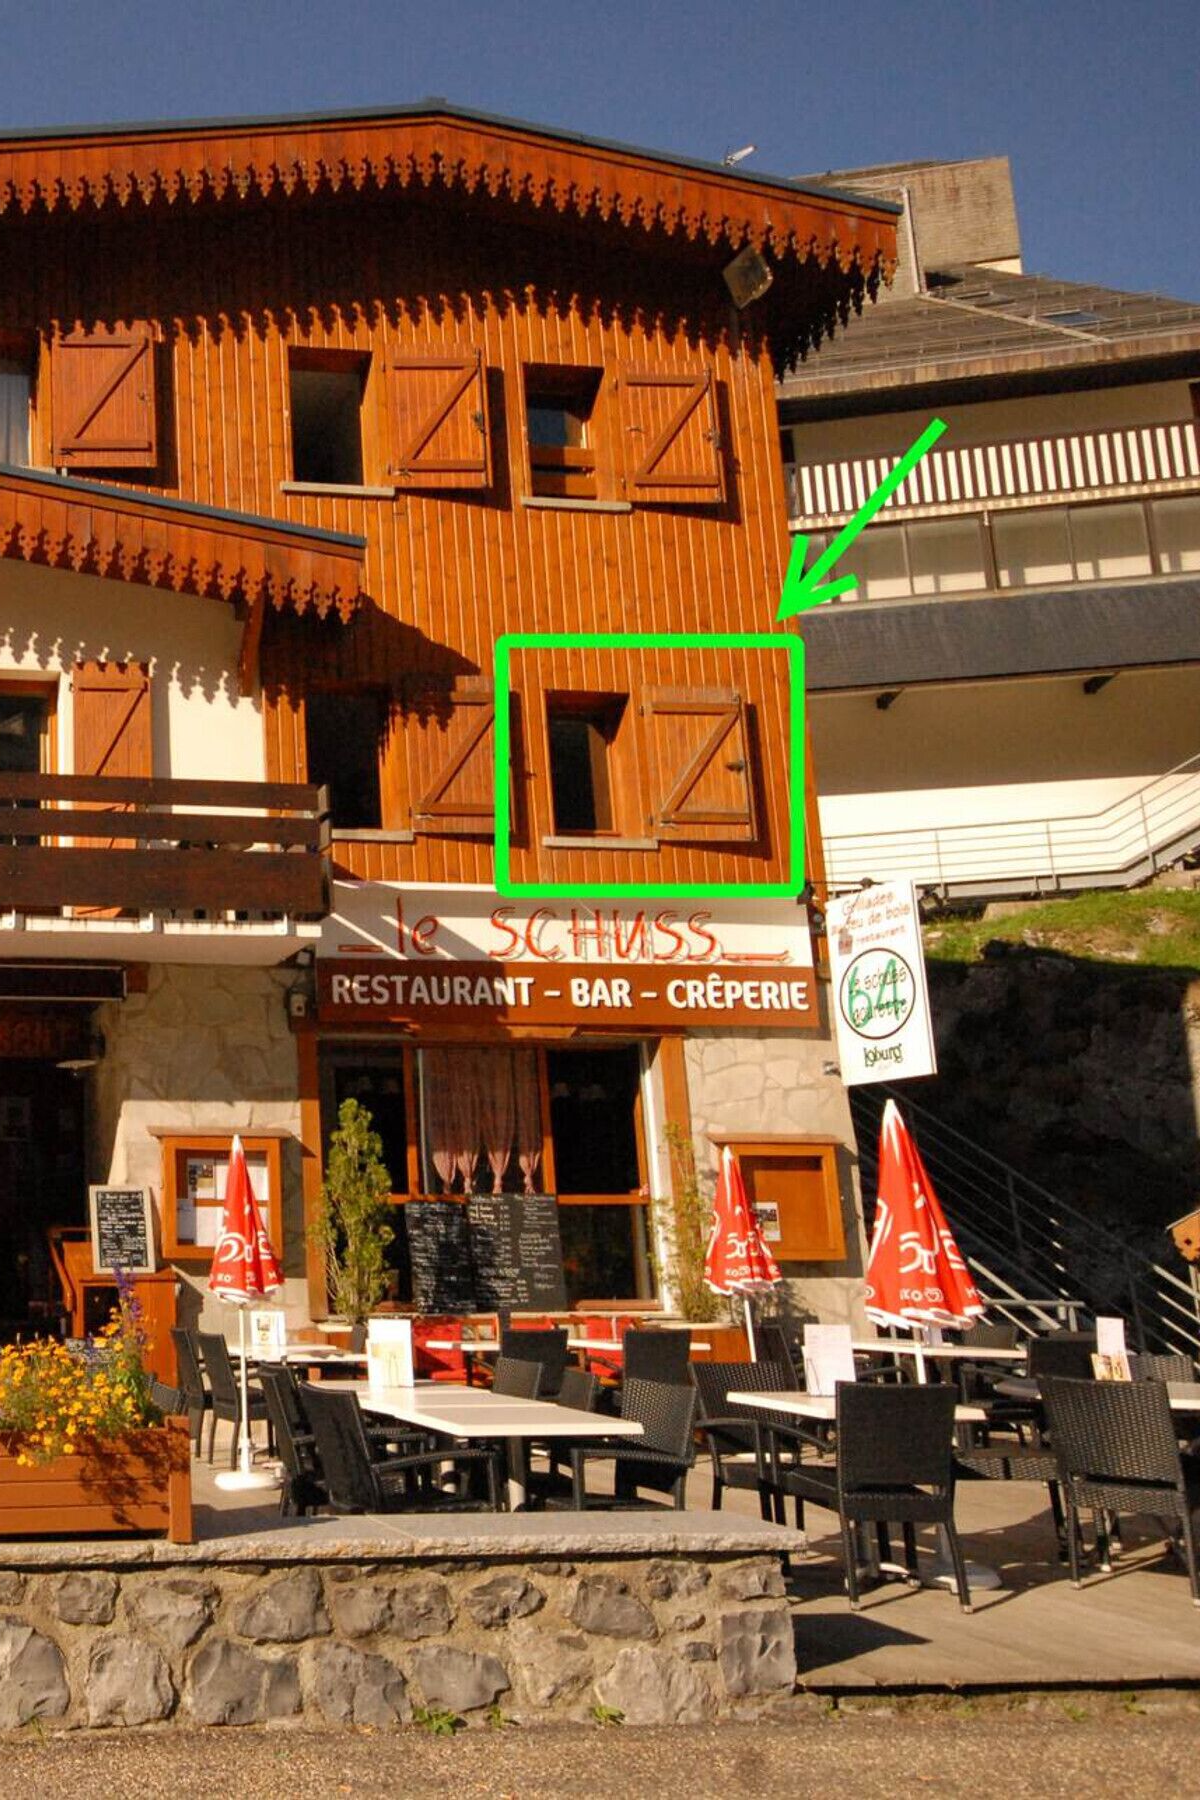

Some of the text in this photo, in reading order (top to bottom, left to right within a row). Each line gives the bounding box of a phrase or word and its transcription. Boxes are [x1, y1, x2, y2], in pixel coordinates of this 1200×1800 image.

[489, 906, 714, 961] SCHUSS
[332, 973, 535, 1008] RESTAURANT
[571, 977, 632, 1009] BAR
[667, 973, 810, 1012] CRÊPERIE
